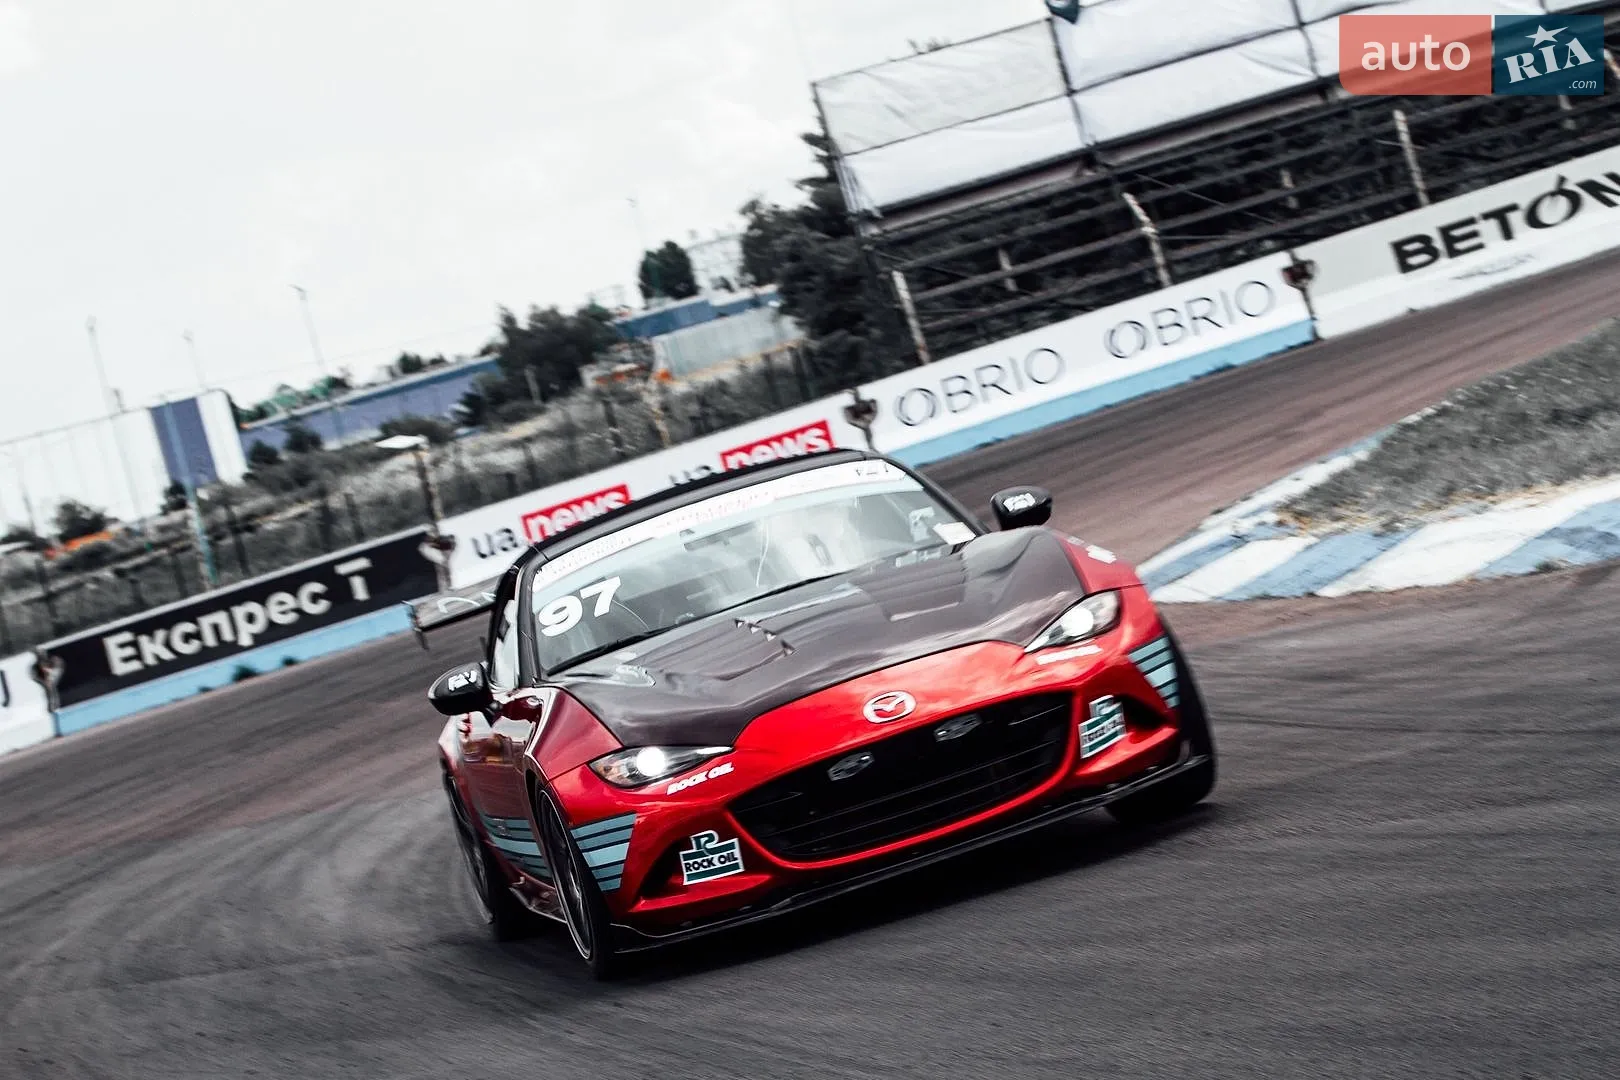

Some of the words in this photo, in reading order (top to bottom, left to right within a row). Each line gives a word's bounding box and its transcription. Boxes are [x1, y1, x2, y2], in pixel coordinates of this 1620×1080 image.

[1104, 280, 1276, 360] OBRIO
[895, 347, 1067, 427] OBRIO
[727, 425, 831, 469] news
[471, 528, 519, 560] ua
[528, 488, 629, 541] news
[103, 580, 331, 676] Експрес
[538, 576, 621, 637] 97
[667, 774, 708, 795] ROCK
[684, 858, 716, 873] ROCK
[718, 851, 738, 865] OIL
